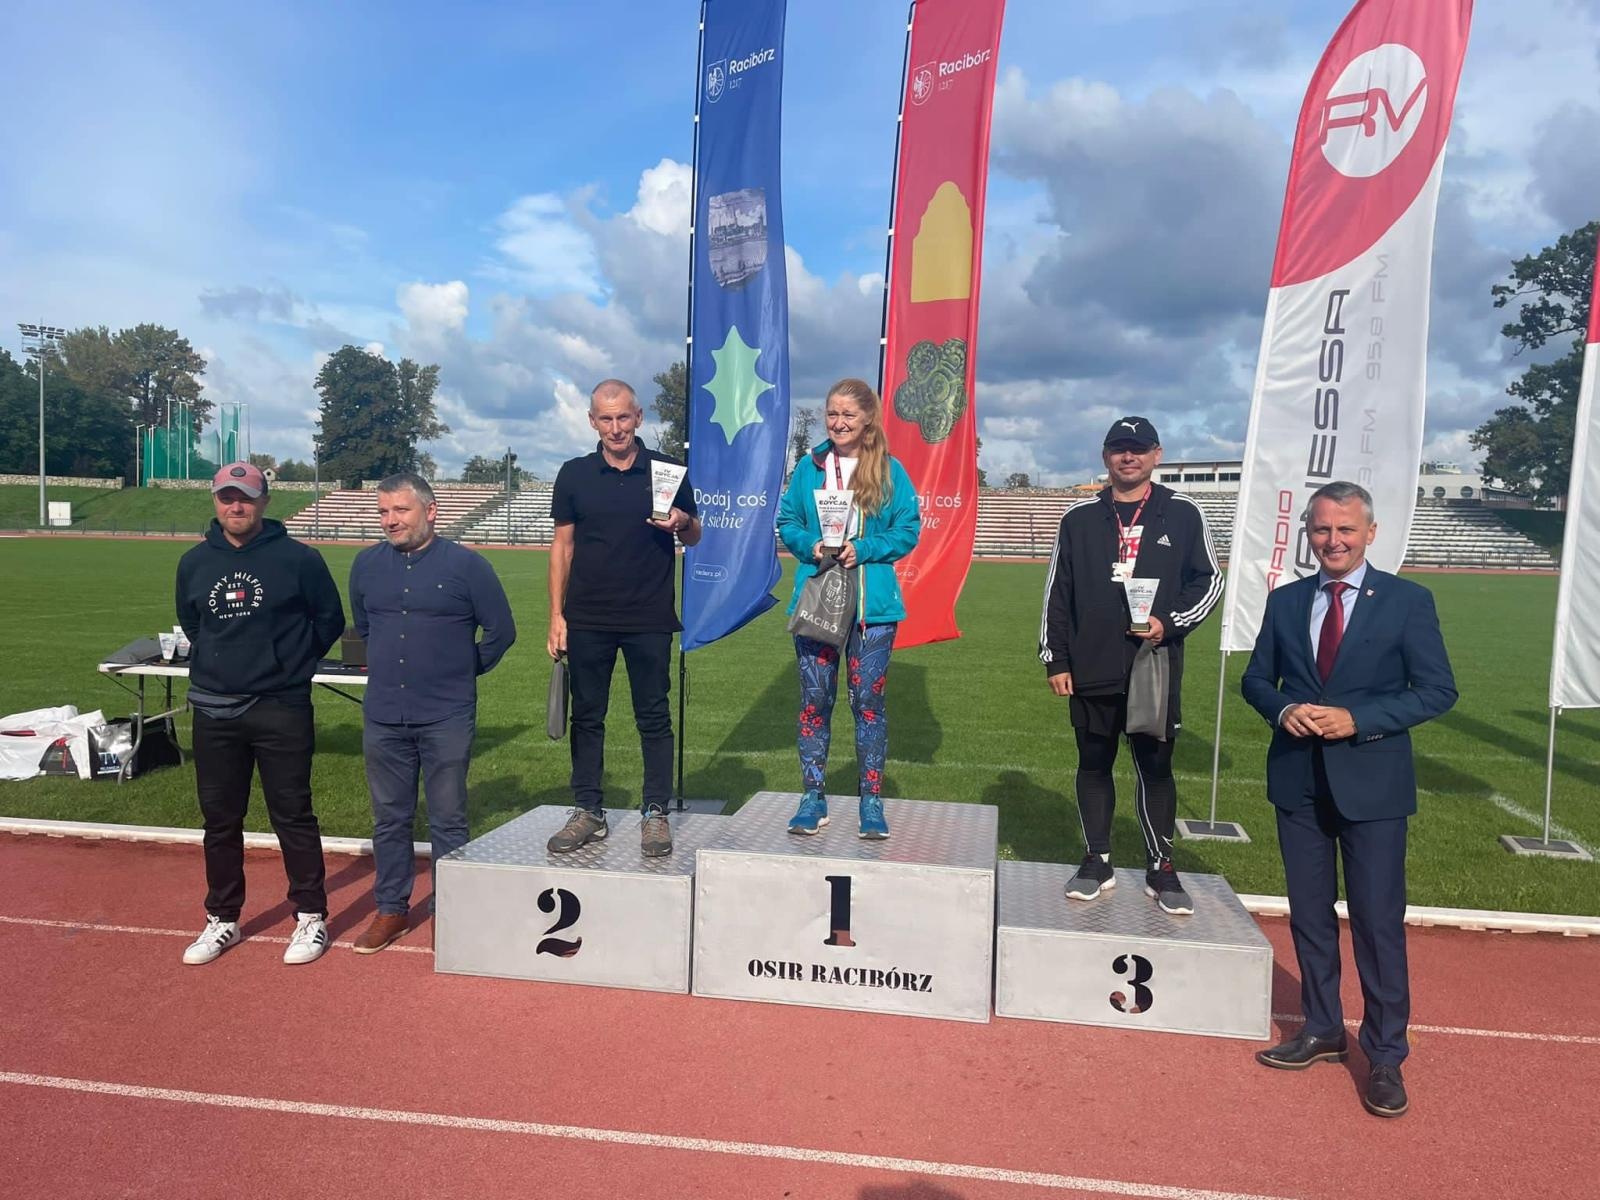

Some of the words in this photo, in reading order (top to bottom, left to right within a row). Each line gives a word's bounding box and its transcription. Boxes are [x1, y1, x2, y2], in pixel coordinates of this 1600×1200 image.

[729, 48, 775, 75] Racibórz
[939, 49, 991, 77] Racibórz
[694, 488, 731, 511] Dodaj
[736, 490, 767, 507] coś
[935, 491, 962, 509] coś
[707, 510, 744, 529] siebie
[208, 575, 228, 614] TOMMY
[234, 572, 264, 608] HILFIGER
[536, 887, 583, 958] 2
[823, 875, 857, 948] 1
[748, 958, 803, 981] OSIR
[811, 963, 933, 993] RACIBÓRZ
[1109, 953, 1154, 1014] 3
